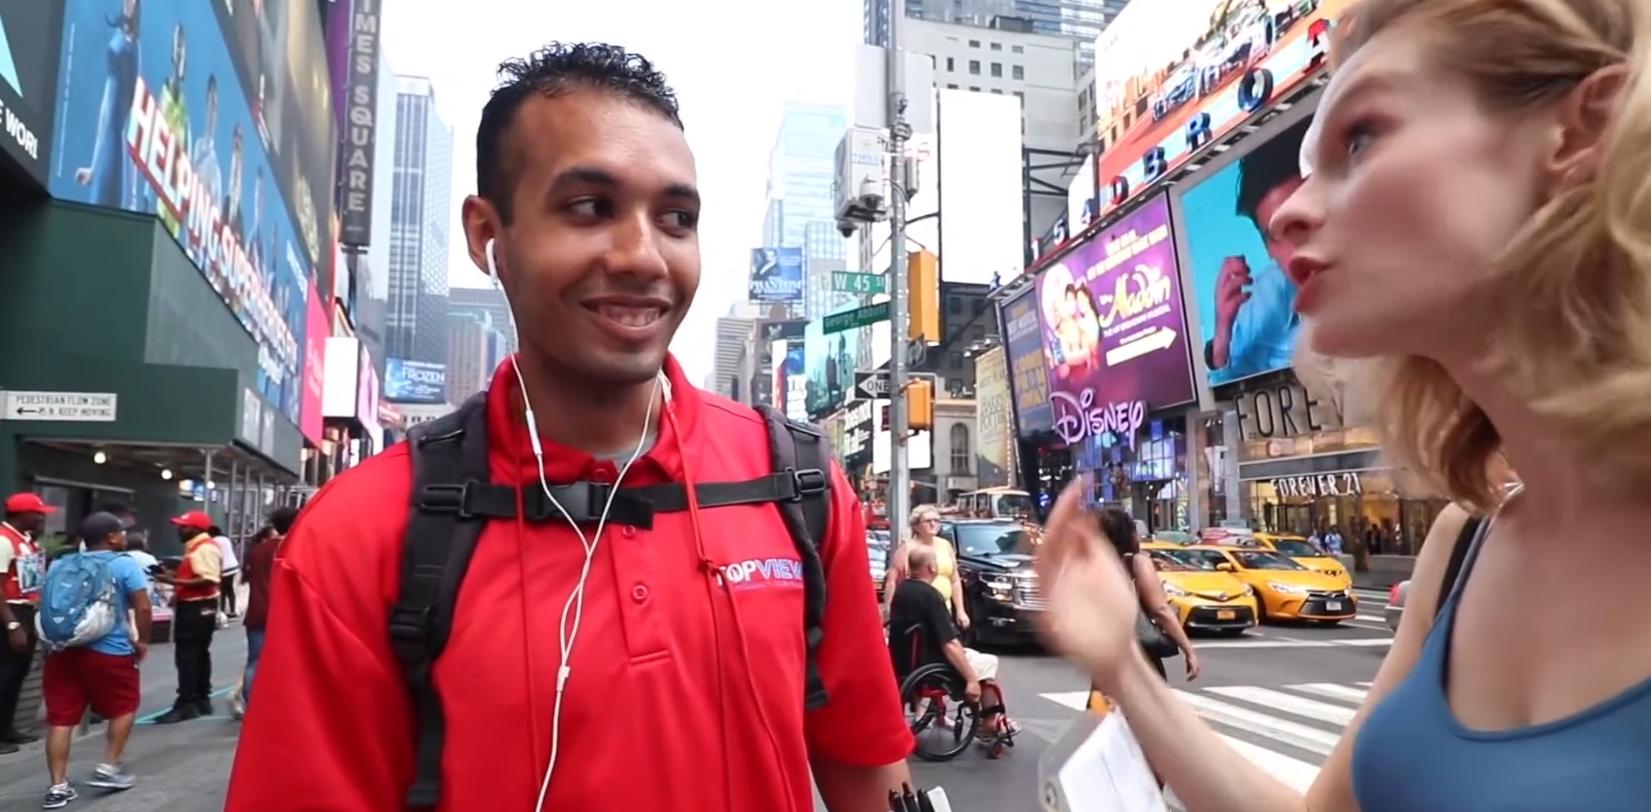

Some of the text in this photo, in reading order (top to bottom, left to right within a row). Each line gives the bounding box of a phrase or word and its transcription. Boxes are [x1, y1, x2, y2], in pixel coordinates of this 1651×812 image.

[348, 85, 373, 212] SQUARE
[834, 274, 848, 289] W
[854, 275, 870, 291] 45
[1099, 264, 1171, 328] Aladdin
[402, 367, 446, 384] FROZEN
[866, 379, 890, 393] ONE
[16, 395, 112, 407] PEDESTRIAN FLOW ZONE
[59, 406, 112, 417] KEEP MOVING
[1270, 472, 1361, 498] FOREVER 21
